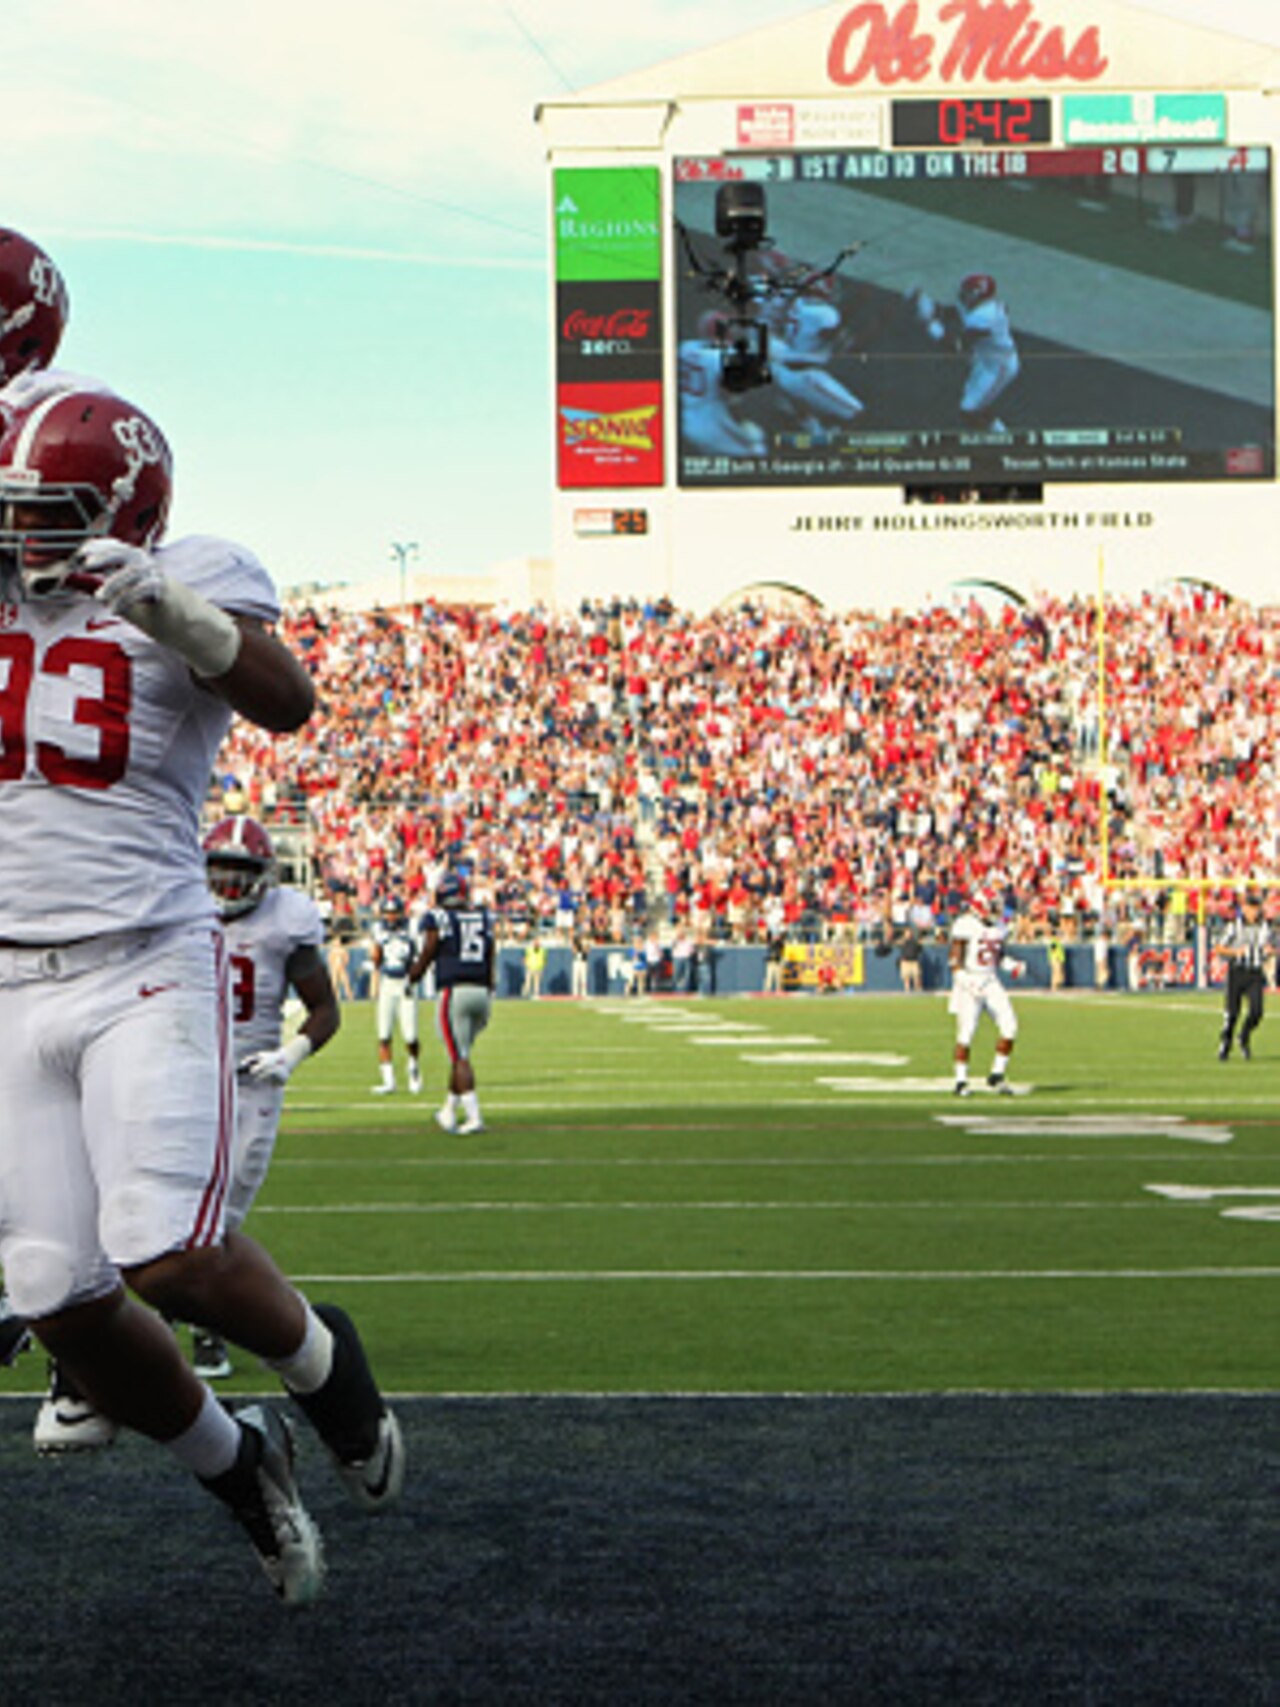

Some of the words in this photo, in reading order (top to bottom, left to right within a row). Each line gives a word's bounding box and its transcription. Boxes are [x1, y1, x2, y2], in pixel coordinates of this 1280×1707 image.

[826, 0, 935, 86] Ole
[938, 0, 1109, 82] Miss
[938, 98, 1033, 143] 0:42
[801, 153, 836, 179] 1ST
[844, 153, 889, 178] AND
[895, 152, 915, 178] 10
[925, 152, 954, 177] ON
[563, 308, 652, 340] Coca-Cola
[112, 416, 162, 468] 93
[873, 512, 1079, 531] HOLLINGSWORTH
[461, 921, 484, 961] 15
